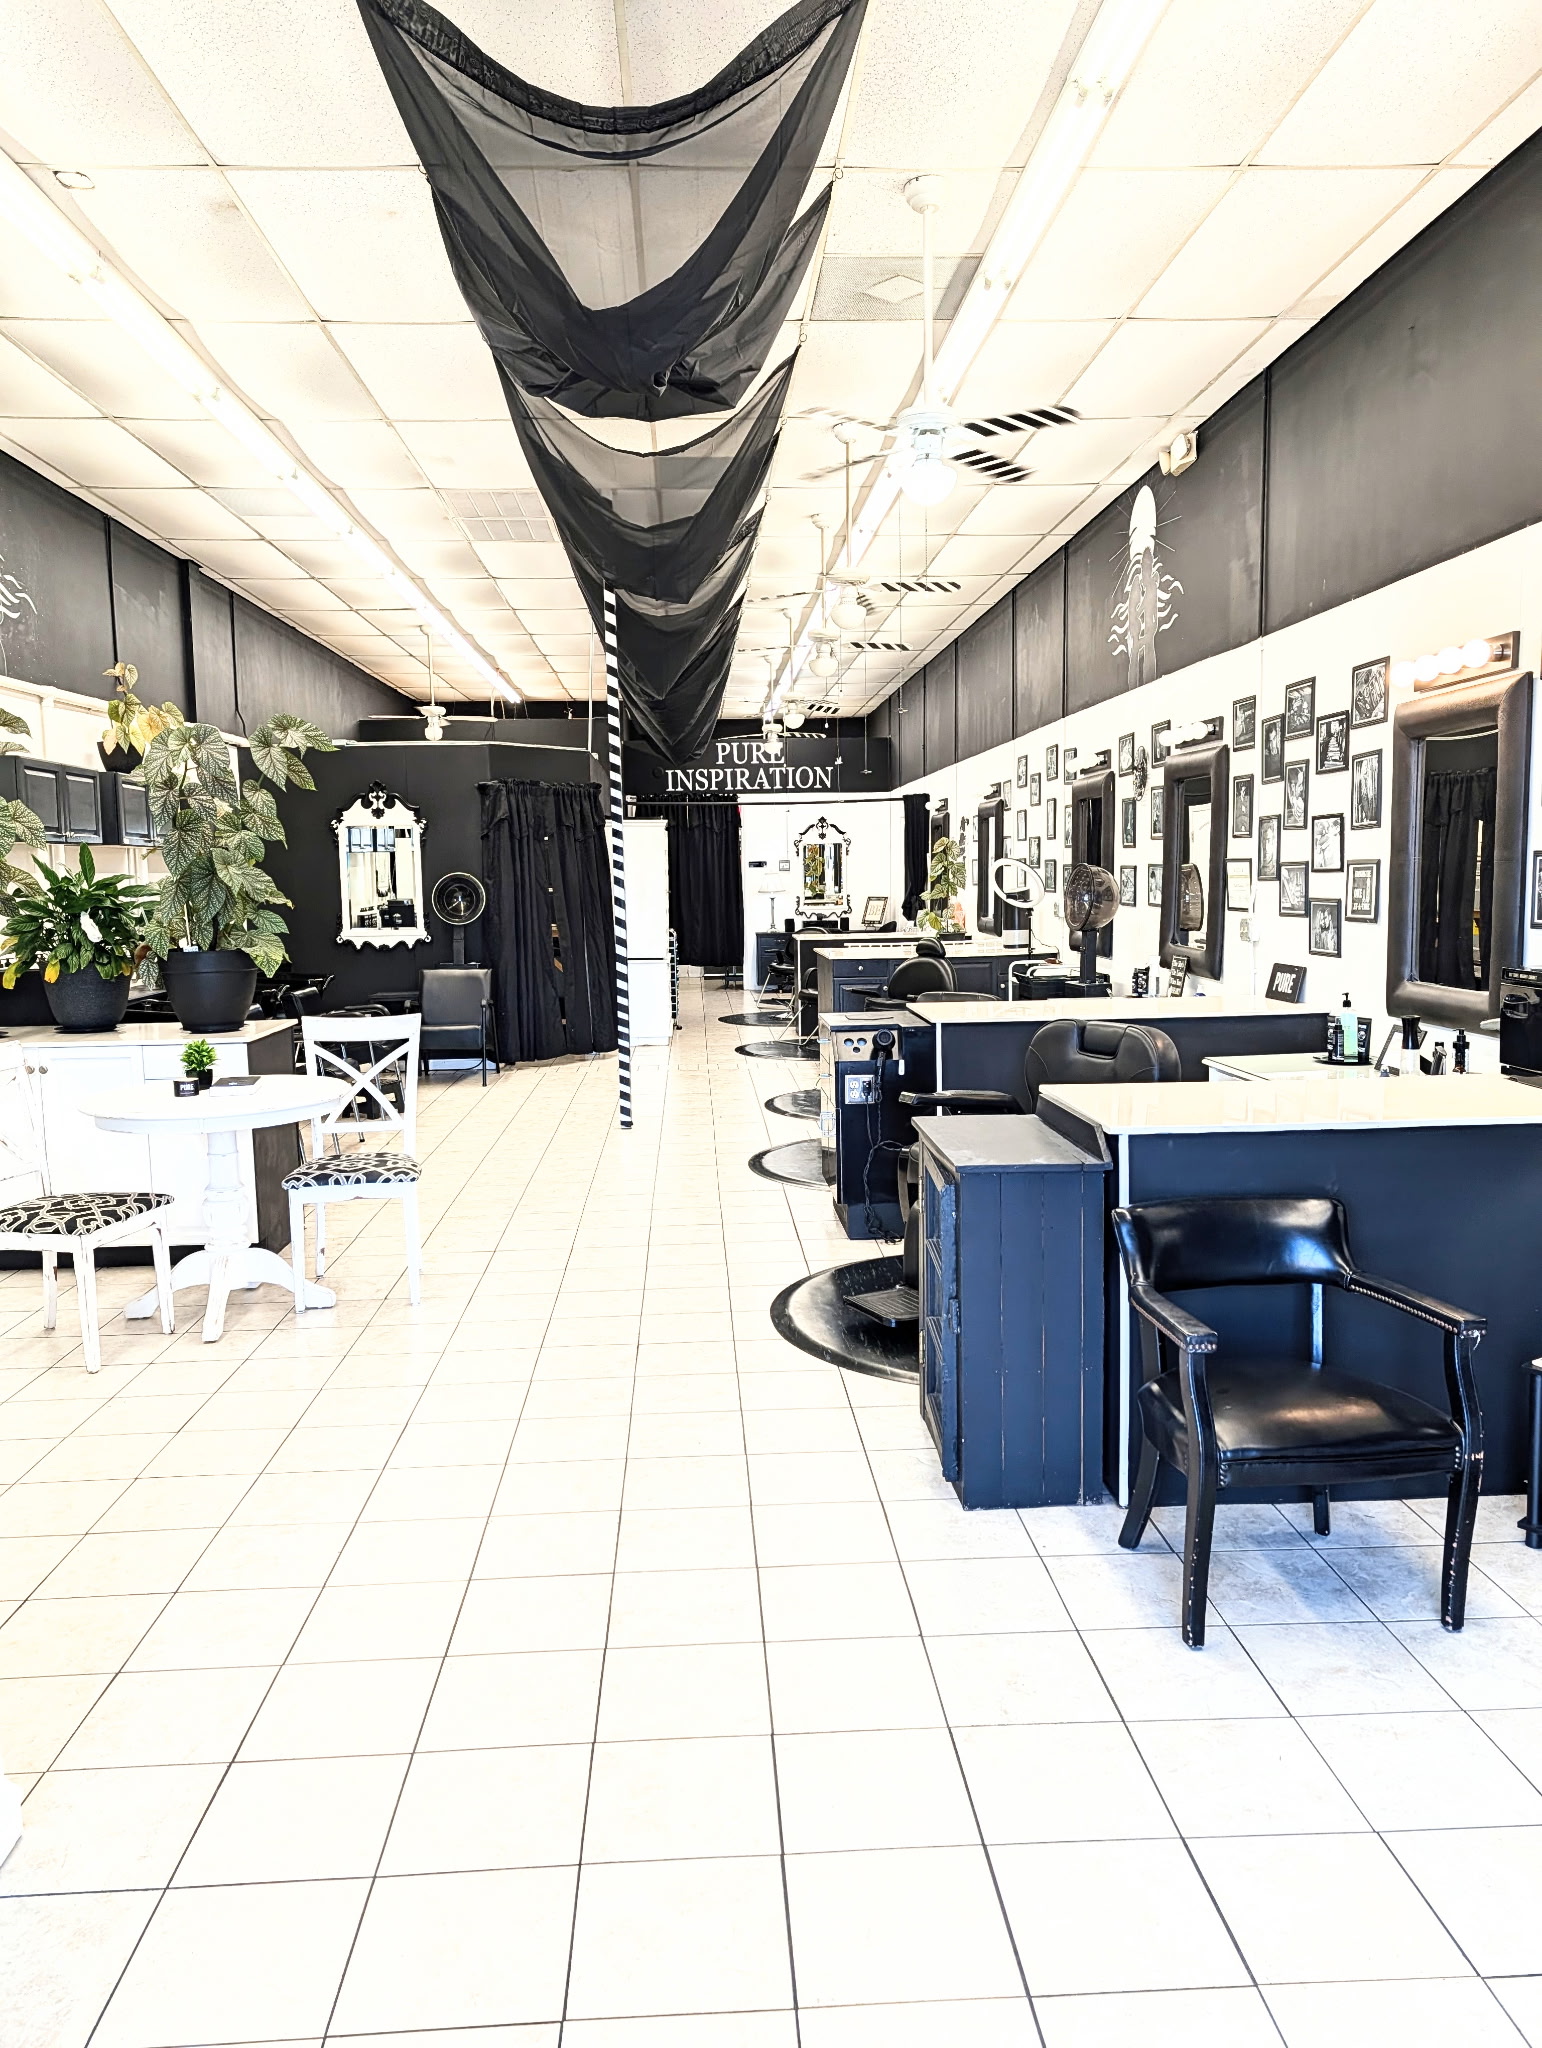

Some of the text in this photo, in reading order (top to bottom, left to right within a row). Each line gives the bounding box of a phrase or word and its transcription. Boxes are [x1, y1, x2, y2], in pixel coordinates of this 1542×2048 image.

[715, 741, 785, 765] PURE
[665, 766, 834, 792] INSPIRATION
[1272, 971, 1297, 994] PURE
